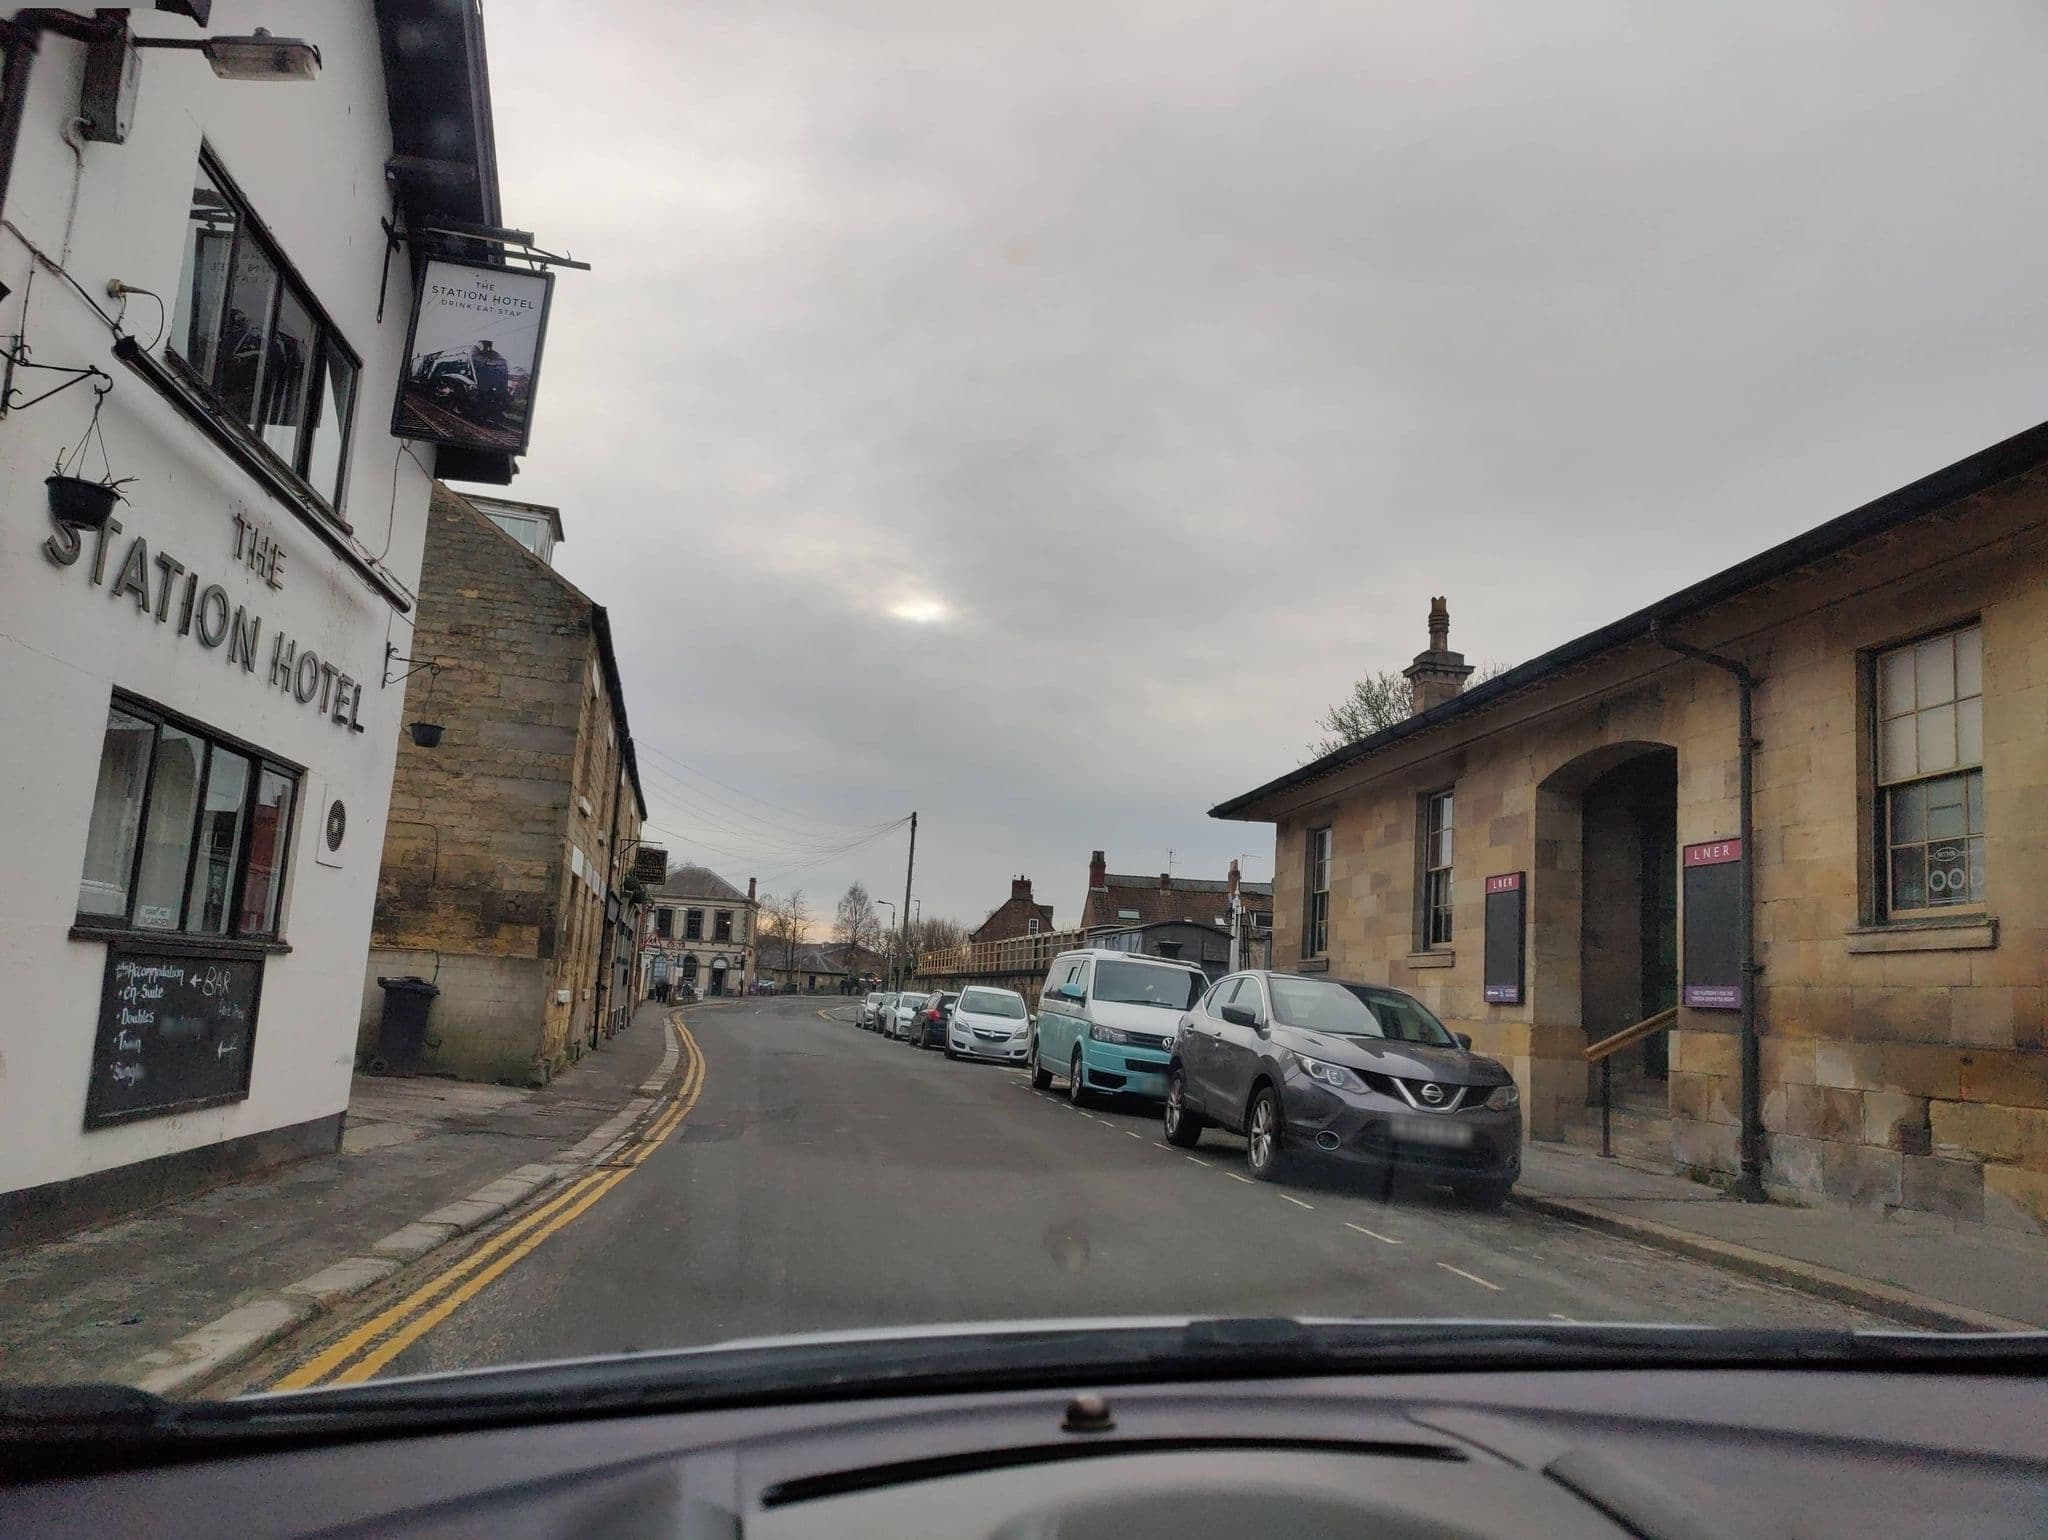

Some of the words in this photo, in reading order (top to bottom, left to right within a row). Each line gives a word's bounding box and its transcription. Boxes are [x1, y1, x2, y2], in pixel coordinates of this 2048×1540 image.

[476, 282, 495, 291] THE
[432, 285, 488, 302] STATION
[493, 295, 534, 309] HOTEL
[442, 299, 472, 310] DRINK
[477, 304, 494, 312] EAT
[498, 308, 521, 317] STAY
[234, 511, 287, 591] THE
[45, 515, 262, 673] STATION
[271, 630, 364, 734] HOTEL
[1693, 844, 1730, 860] LNER
[1492, 877, 1513, 890] LNER
[203, 966, 232, 997] BAR
[121, 1007, 155, 1025] Doubles
